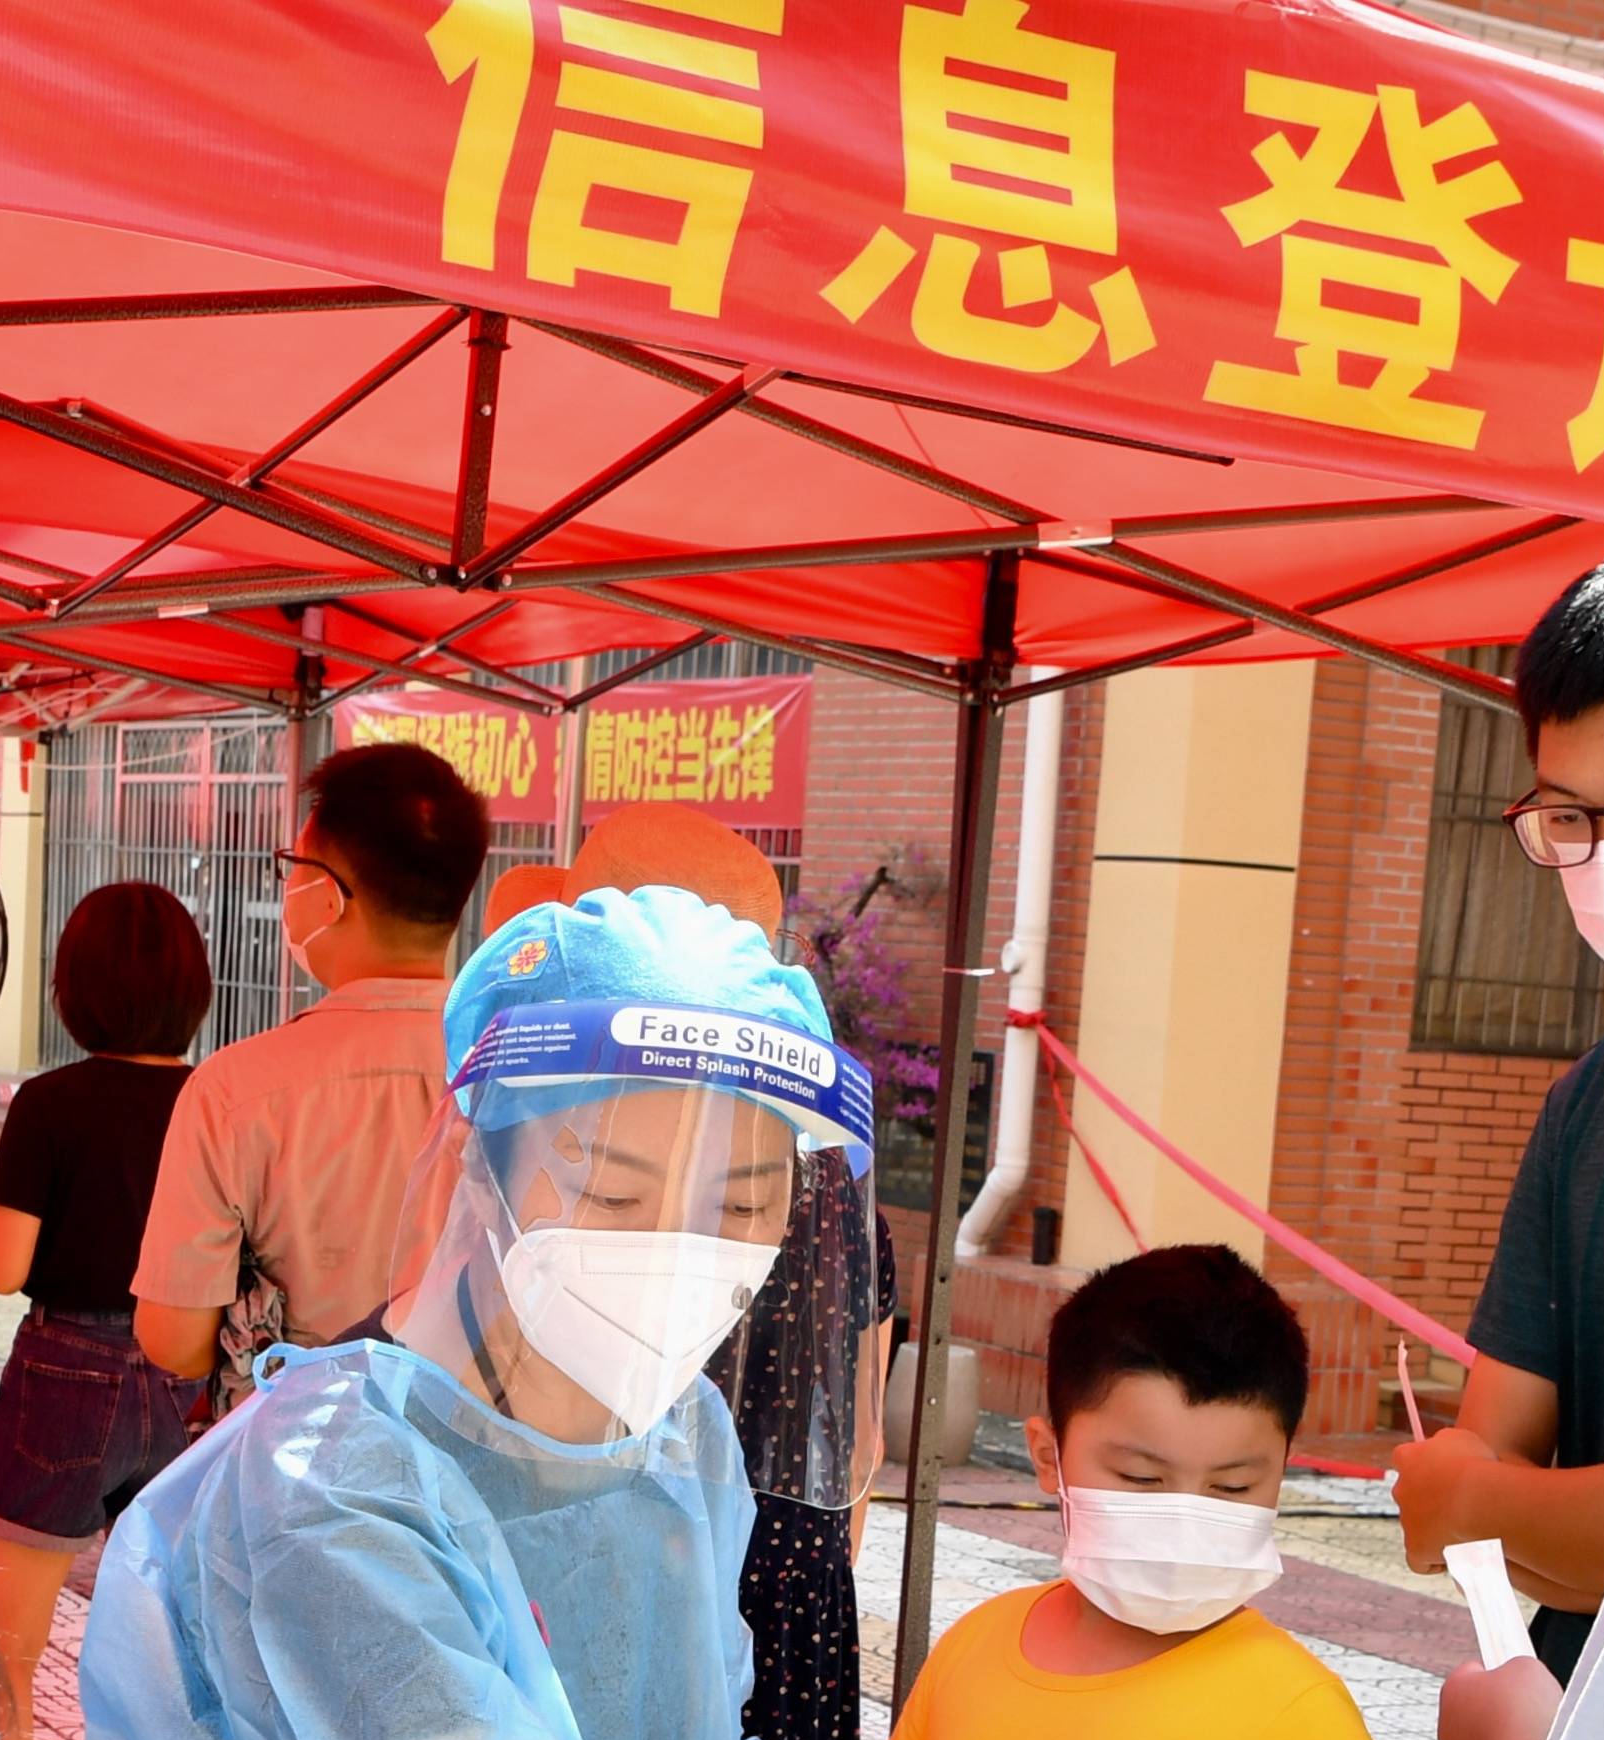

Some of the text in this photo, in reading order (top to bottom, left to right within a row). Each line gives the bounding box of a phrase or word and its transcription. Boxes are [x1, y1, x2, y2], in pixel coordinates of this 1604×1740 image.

[639, 1015, 821, 1078] Face Shield
[641, 1050, 816, 1100] Direct Splash Protection
